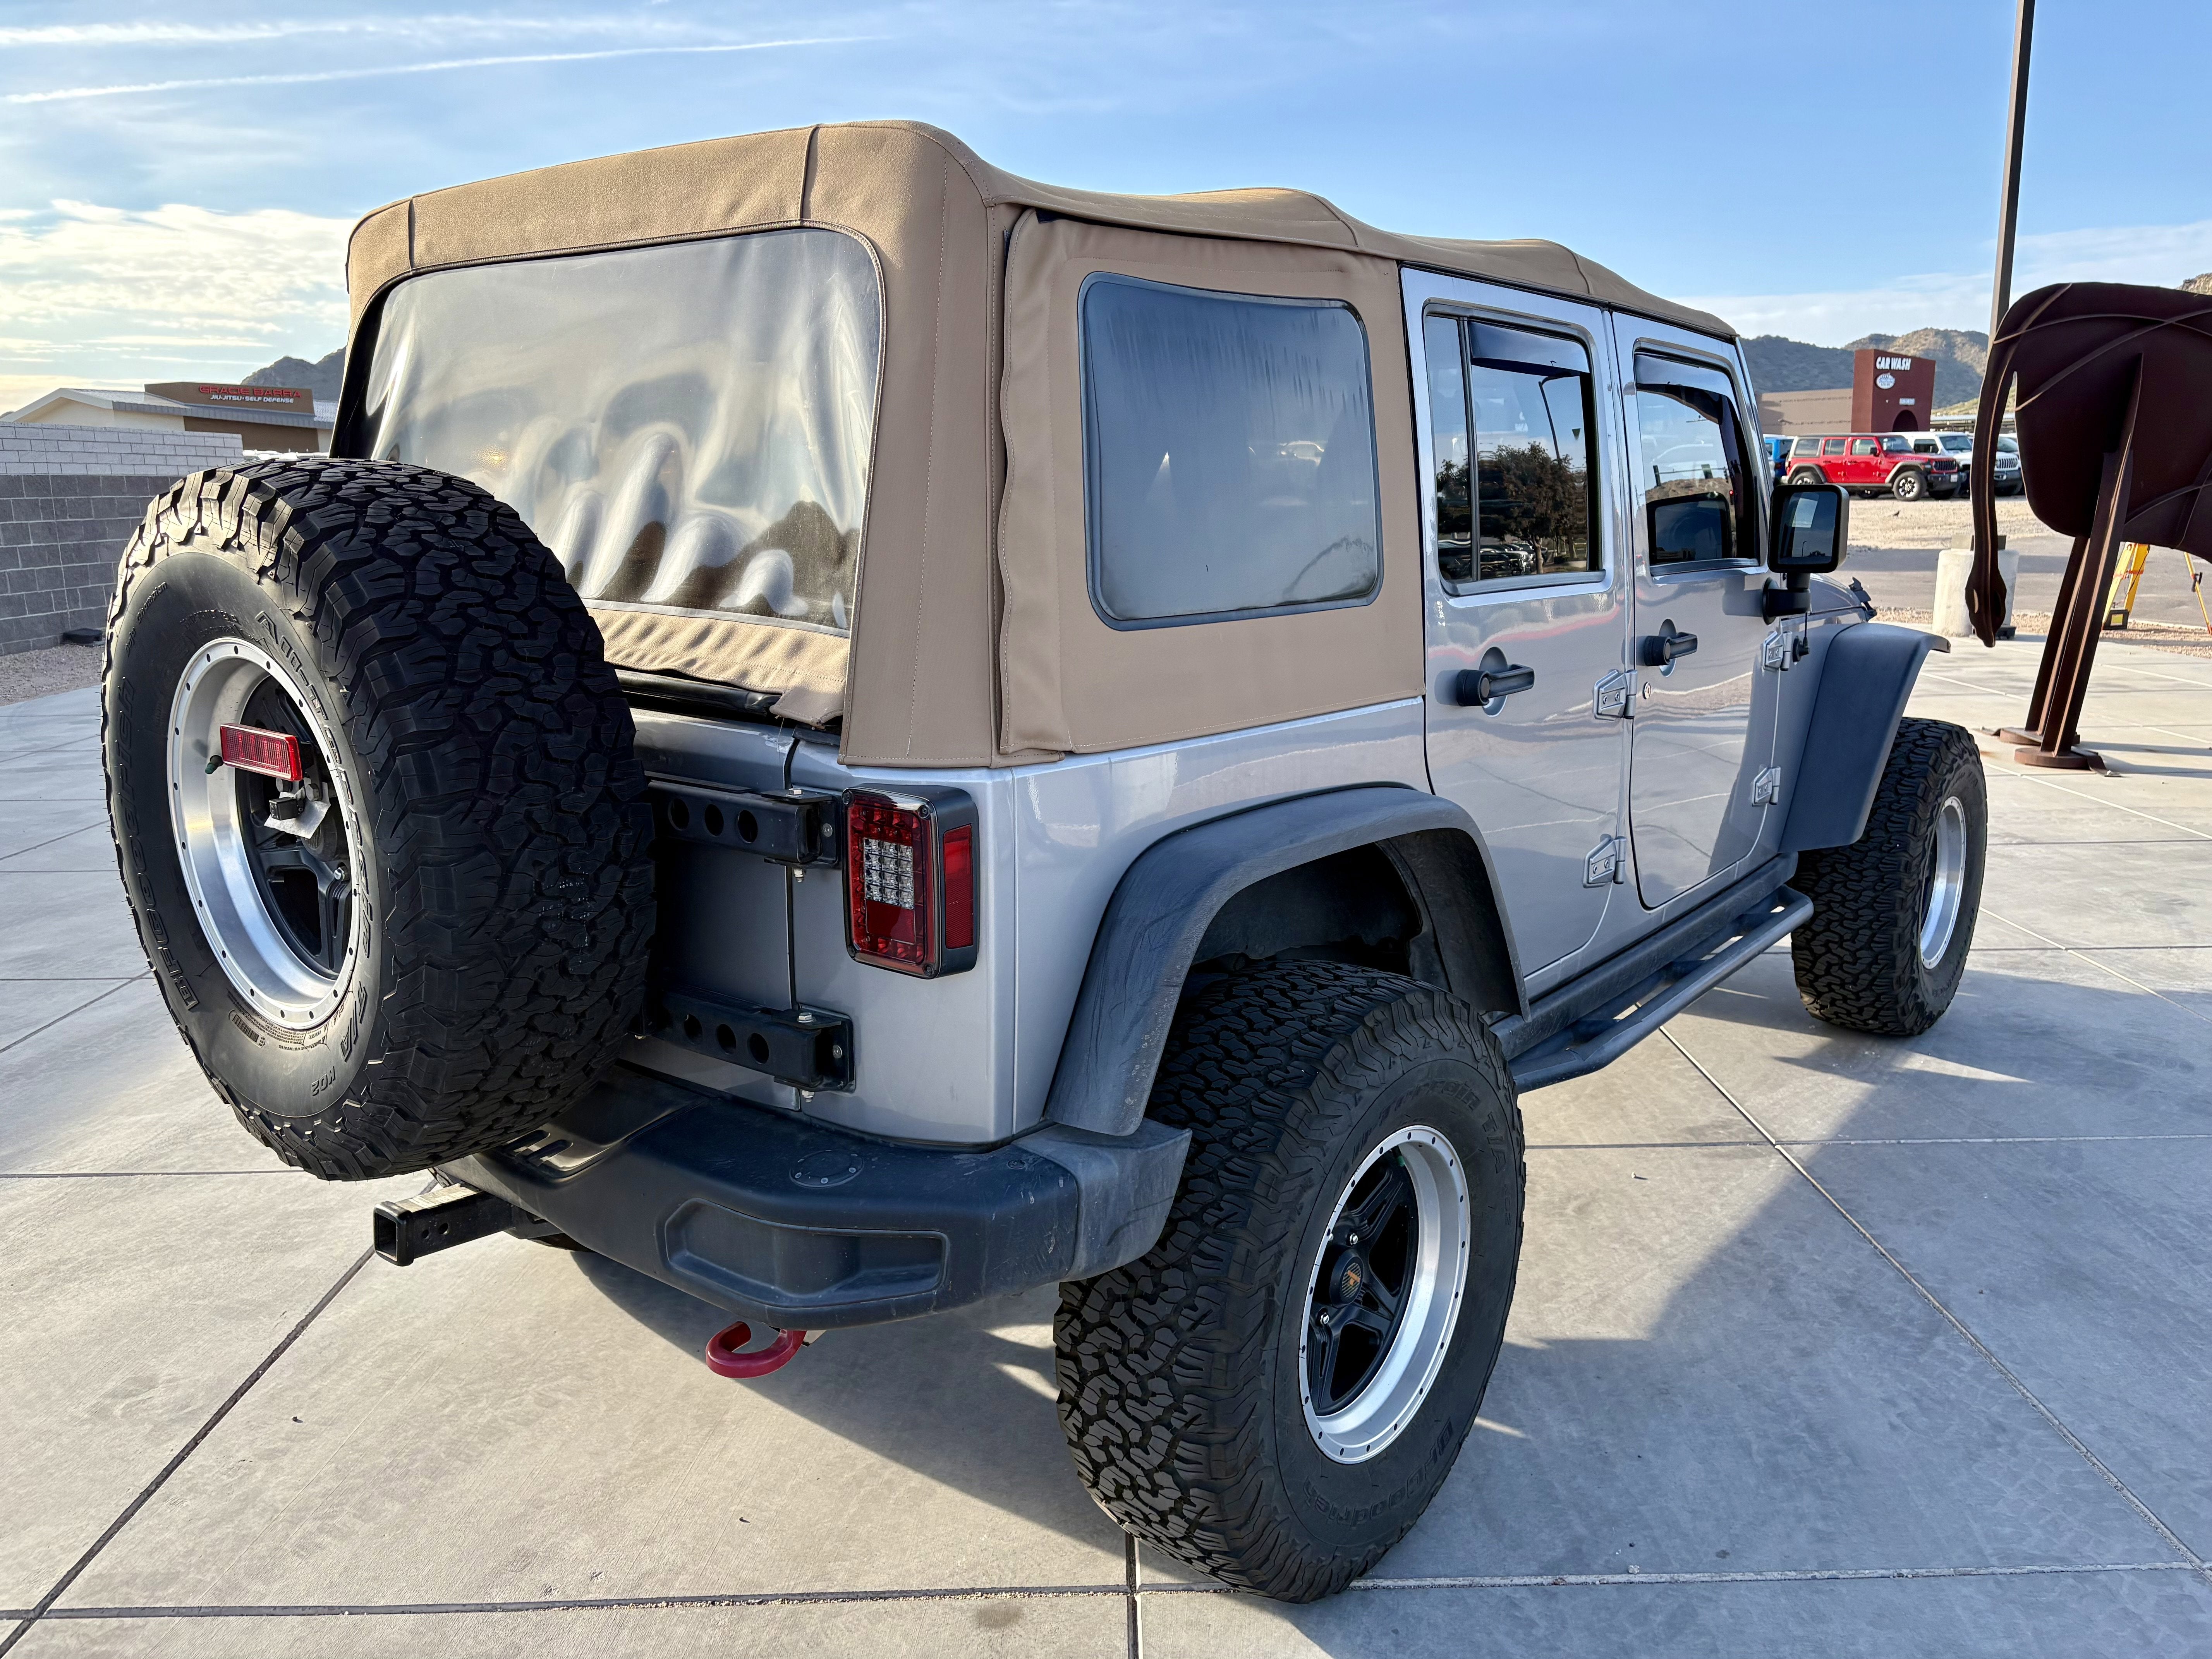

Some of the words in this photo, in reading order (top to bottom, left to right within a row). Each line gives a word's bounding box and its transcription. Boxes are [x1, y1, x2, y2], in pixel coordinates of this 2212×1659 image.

[199, 385, 249, 395] GRACIE
[254, 388, 302, 398] BARRA
[1876, 356, 1890, 369] CAR
[1891, 357, 1911, 370] WASH
[116, 675, 199, 1012] BFGoodrich
[1303, 1417, 1454, 1530] BFGoodrich
